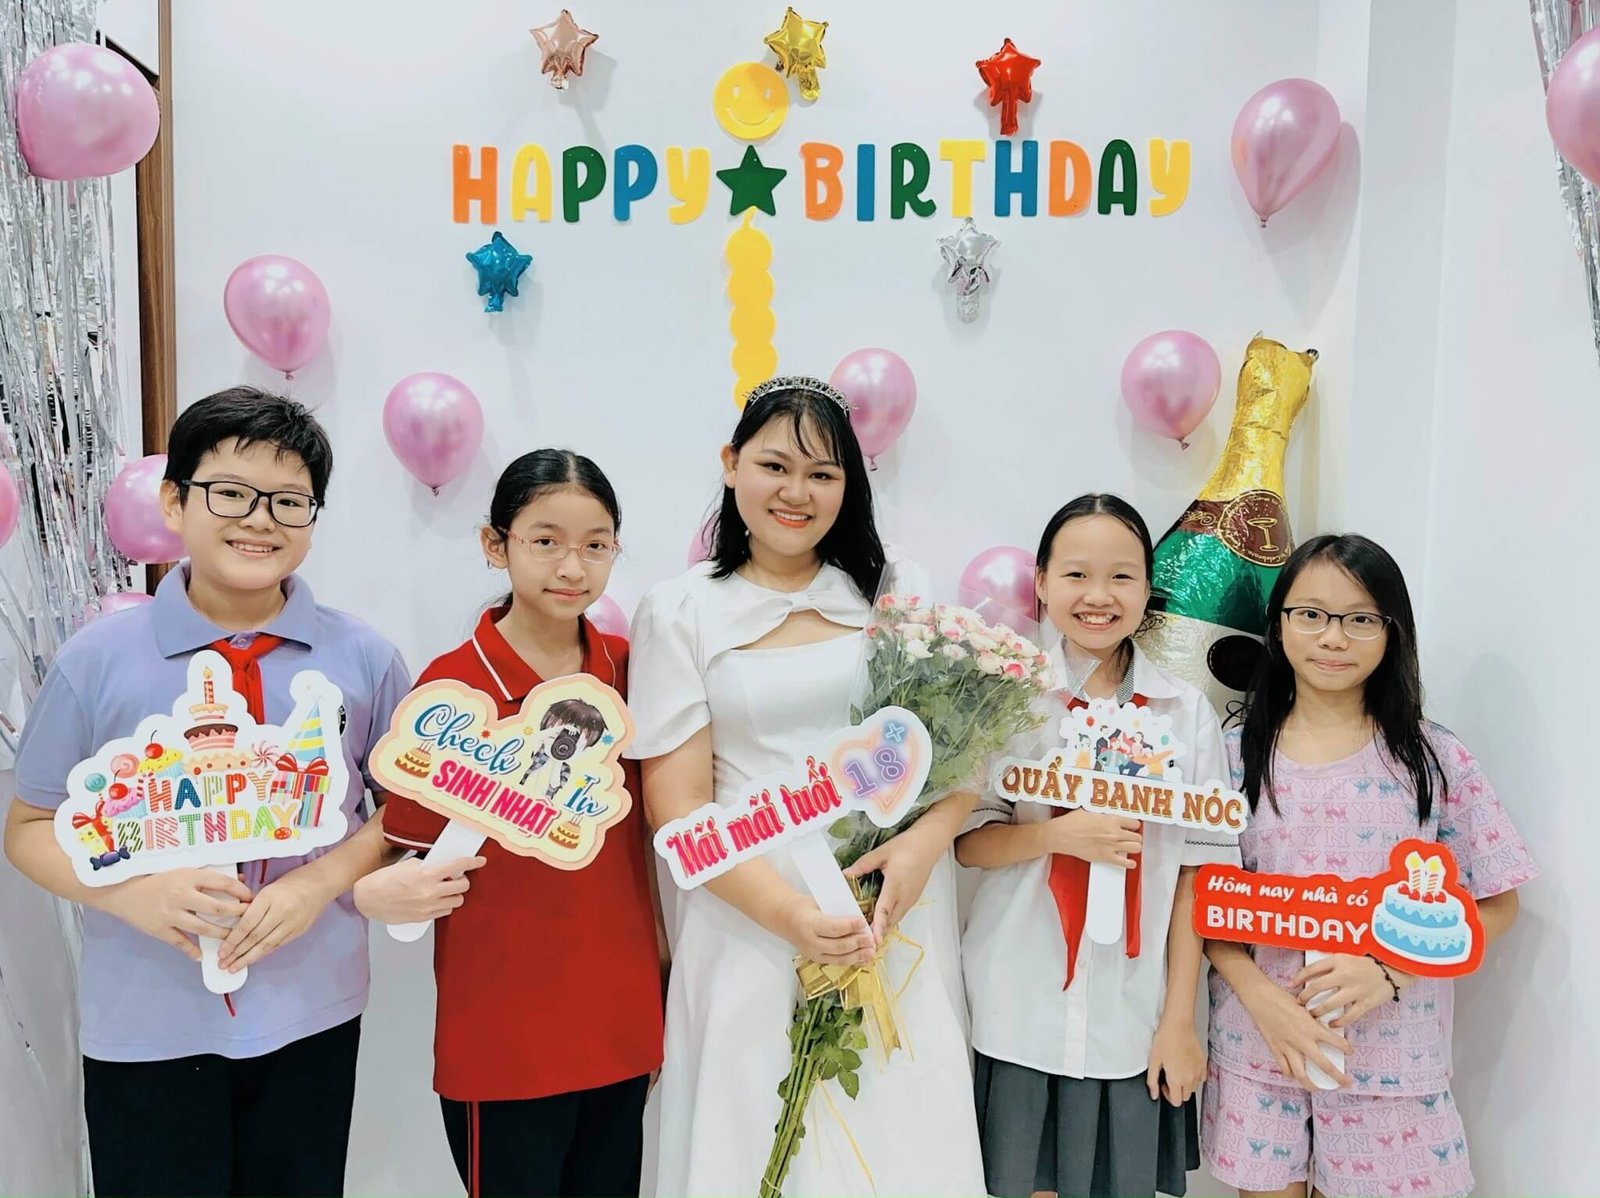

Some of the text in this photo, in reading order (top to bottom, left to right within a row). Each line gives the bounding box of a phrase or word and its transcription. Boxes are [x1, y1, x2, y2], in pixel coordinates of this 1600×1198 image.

[452, 138, 1192, 224] HAPPY BIRTHDAY
[414, 703, 525, 775] Check
[149, 770, 274, 812] HAPPY
[432, 759, 497, 808] SINH
[563, 774, 608, 817] In
[1090, 778, 1174, 818] BANH
[1182, 788, 1242, 828] NÓC
[666, 816, 728, 878] Mãi
[726, 789, 785, 852] mãi
[780, 755, 842, 826] tuổi
[1207, 875, 1369, 907] Hôm nay nhà có
[1206, 905, 1369, 945] BIRTHDAY
